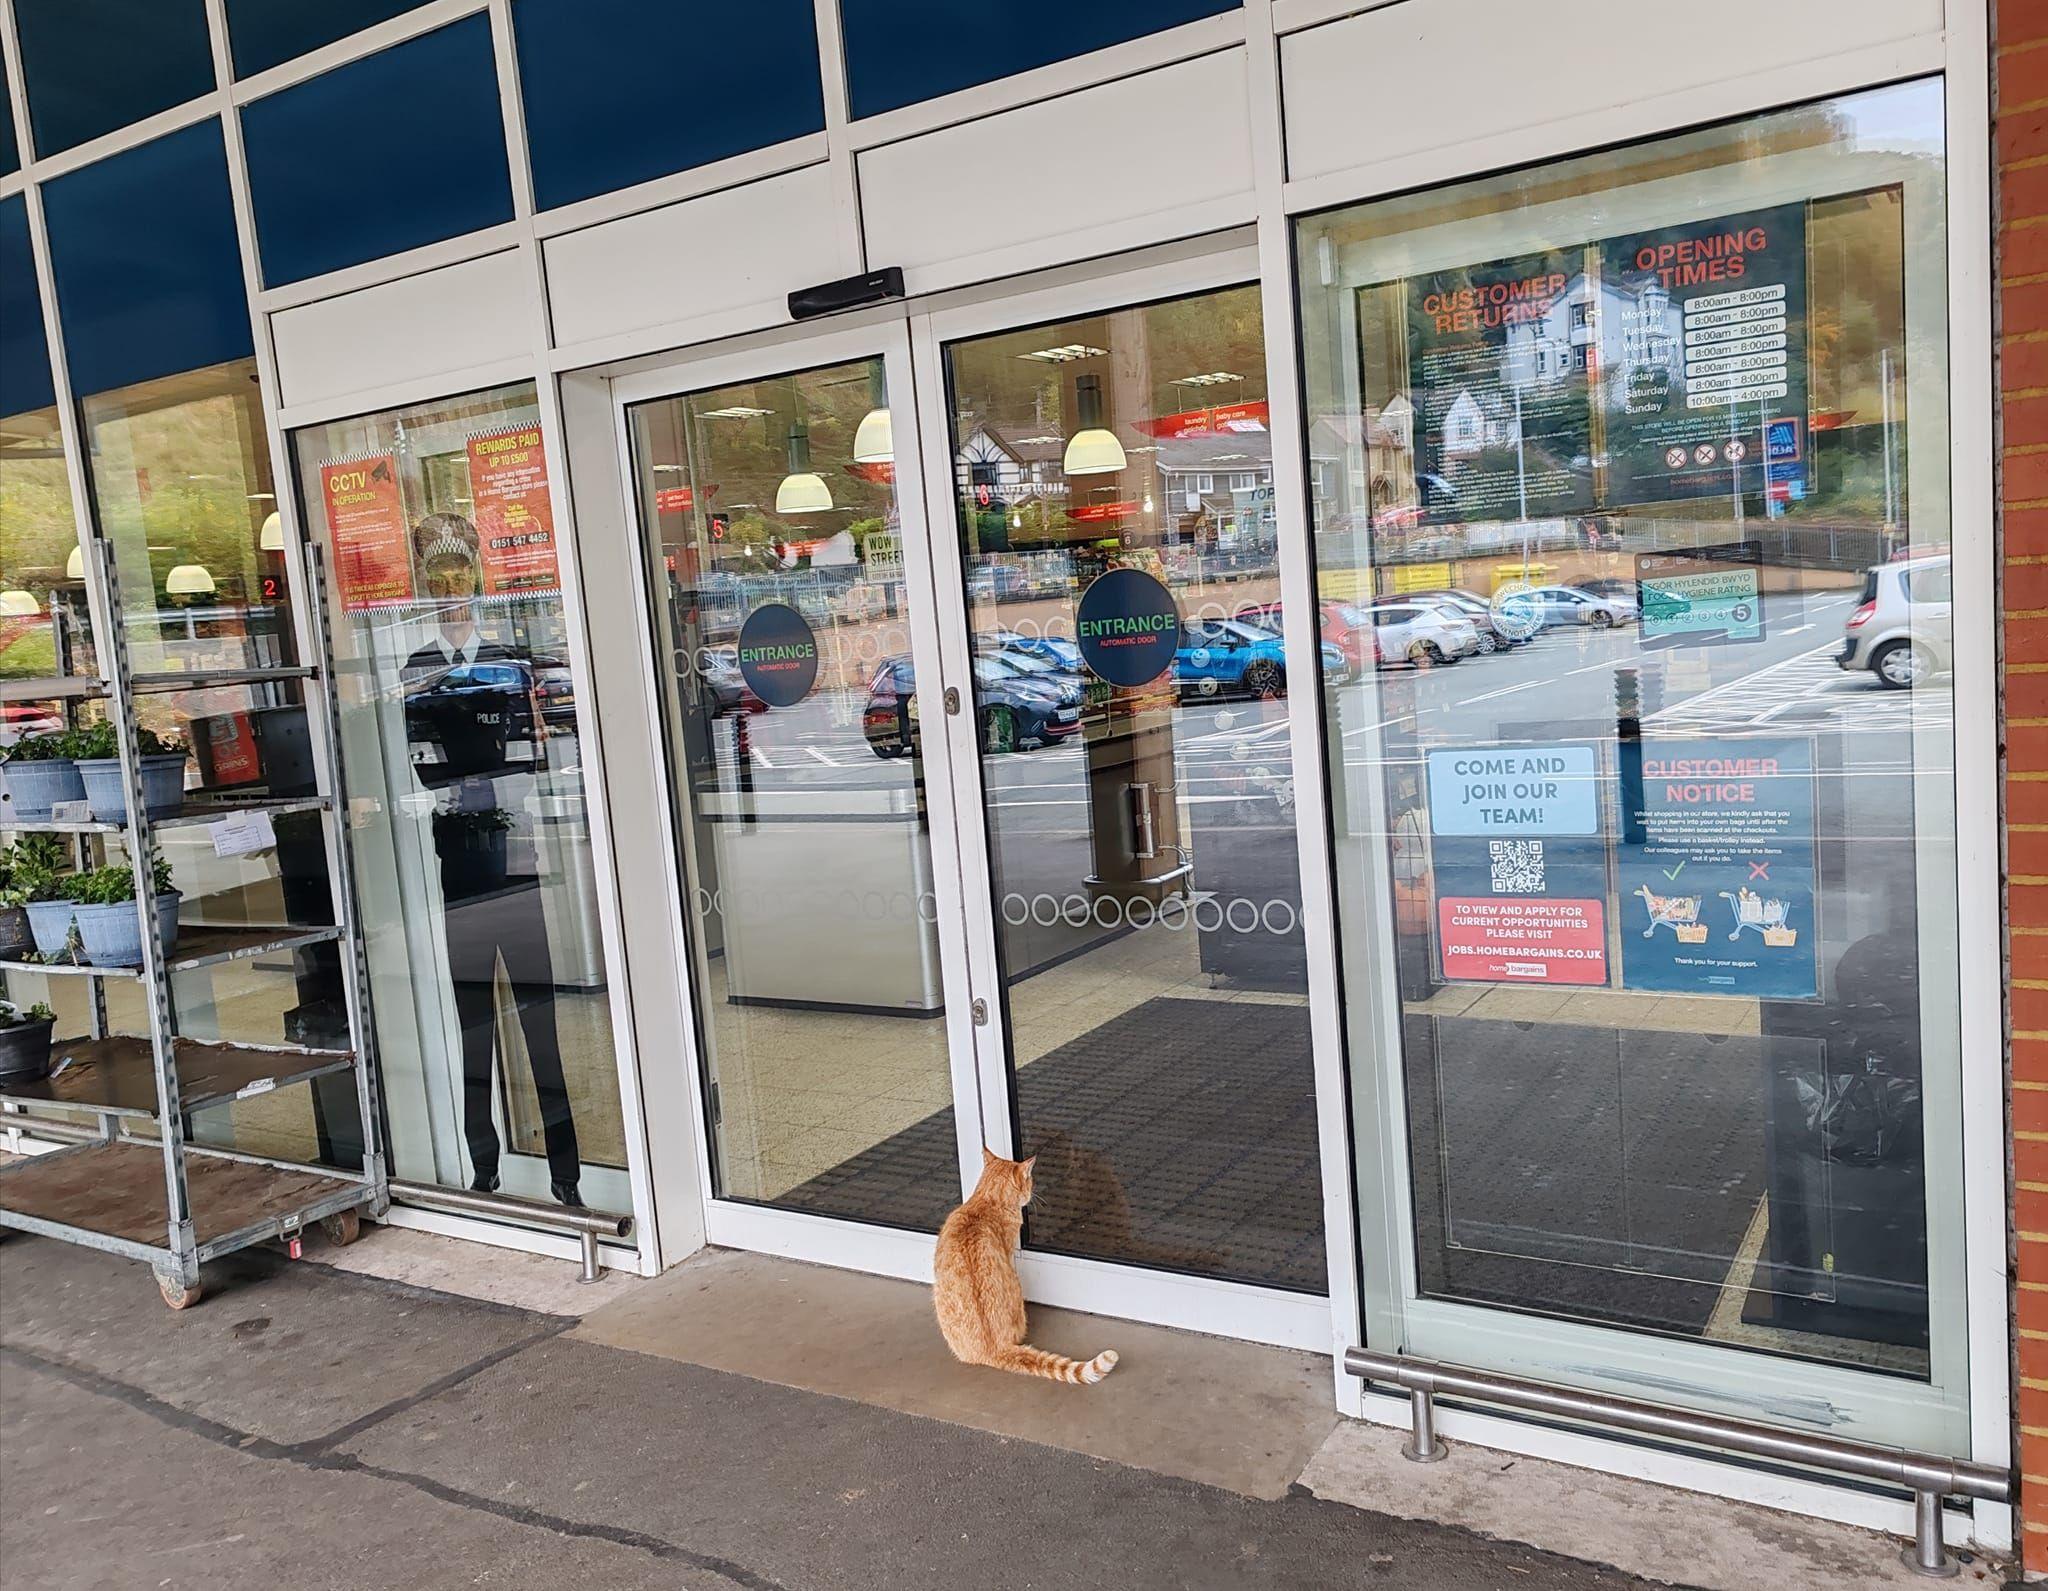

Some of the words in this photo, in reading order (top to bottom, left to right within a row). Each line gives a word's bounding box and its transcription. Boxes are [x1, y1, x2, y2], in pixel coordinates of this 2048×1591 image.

[1636, 227, 1767, 270] OPENING
[1656, 256, 1745, 288] TIMES
[1423, 273, 1566, 315] CUSTOMER
[1622, 307, 1662, 321] Monday
[1694, 296, 1730, 309] 8:00am
[1740, 289, 1778, 302] 8:00pm
[1435, 300, 1550, 336] RETURNS
[1622, 323, 1664, 337] Tuesday
[1695, 313, 1731, 325] 8:00am
[1740, 305, 1778, 319] 8:00pm
[1623, 336, 1681, 351] Wednesday
[1695, 329, 1731, 342] 8:00am
[1740, 322, 1778, 336] 8:00pm
[1623, 353, 1670, 368] Thursday
[1695, 345, 1731, 358] 8:00am
[1741, 338, 1778, 352] 8:00pm
[1624, 371, 1655, 383] Friday
[1696, 362, 1731, 374] 8:00am
[1741, 355, 1778, 368] 8:00pm
[1625, 385, 1669, 399] Saturday
[1696, 378, 1731, 390] 8:00am
[1741, 372, 1779, 384] 8:00pm
[1625, 402, 1662, 414] Sunday
[1692, 394, 1732, 407] 10:00am
[1741, 388, 1779, 401] 4:00pm
[1185, 416, 1207, 425] laundry
[1216, 412, 1231, 420] baby
[1684, 422, 1709, 431] OPENING
[476, 436, 517, 456] REWARDS
[519, 432, 539, 448] PAID
[489, 457, 500, 468] UP
[501, 455, 510, 465] TO
[511, 452, 528, 464] £500
[330, 471, 366, 492] CCTV
[340, 491, 376, 505] OPERATION
[980, 484, 988, 505] 6
[1251, 487, 1274, 501] TOP
[713, 519, 724, 539] 5
[492, 538, 511, 549] 0151
[512, 536, 526, 545] 547
[529, 533, 548, 543] 4452
[868, 536, 892, 550] WOW
[870, 550, 903, 566] STREET
[265, 580, 276, 595] 2
[1675, 577, 1719, 588] HYLENDID
[1722, 574, 1751, 583] BWYD
[1718, 584, 1751, 593] RATING
[1080, 614, 1175, 637] ENTRANCE
[1100, 637, 1136, 647] AUTOMATIC
[741, 644, 814, 663] ENTRANCE
[757, 663, 784, 671] AUTOMATIC
[477, 712, 500, 724] POLICE
[1454, 759, 1515, 775] COME
[1521, 758, 1565, 774] AND
[1644, 758, 1778, 777] CUSTOMER
[1462, 784, 1506, 804] JOIN
[1513, 783, 1558, 799] OUR
[1666, 783, 1755, 802] NOTICE
[1480, 807, 1544, 824] TEAM!
[1654, 810, 1682, 818] shopping
[1731, 810, 1749, 818] kindly
[1656, 848, 1688, 856] colleagues
[1456, 905, 1470, 914] TO
[1472, 906, 1497, 914] VIEW
[1500, 906, 1522, 915] AND
[1524, 907, 1557, 916] APPLY
[1560, 908, 1583, 916] FOR
[1452, 917, 1500, 926] CURRENT
[1502, 918, 1588, 928] OPPORTUNITIES
[1486, 928, 1524, 938] PLEASE
[1527, 930, 1553, 939] VISIT
[1448, 945, 1602, 959] JOBS.HOMEBARGAINS.CO.UK
[1489, 964, 1508, 972] home
[1511, 965, 1544, 974] bargains
